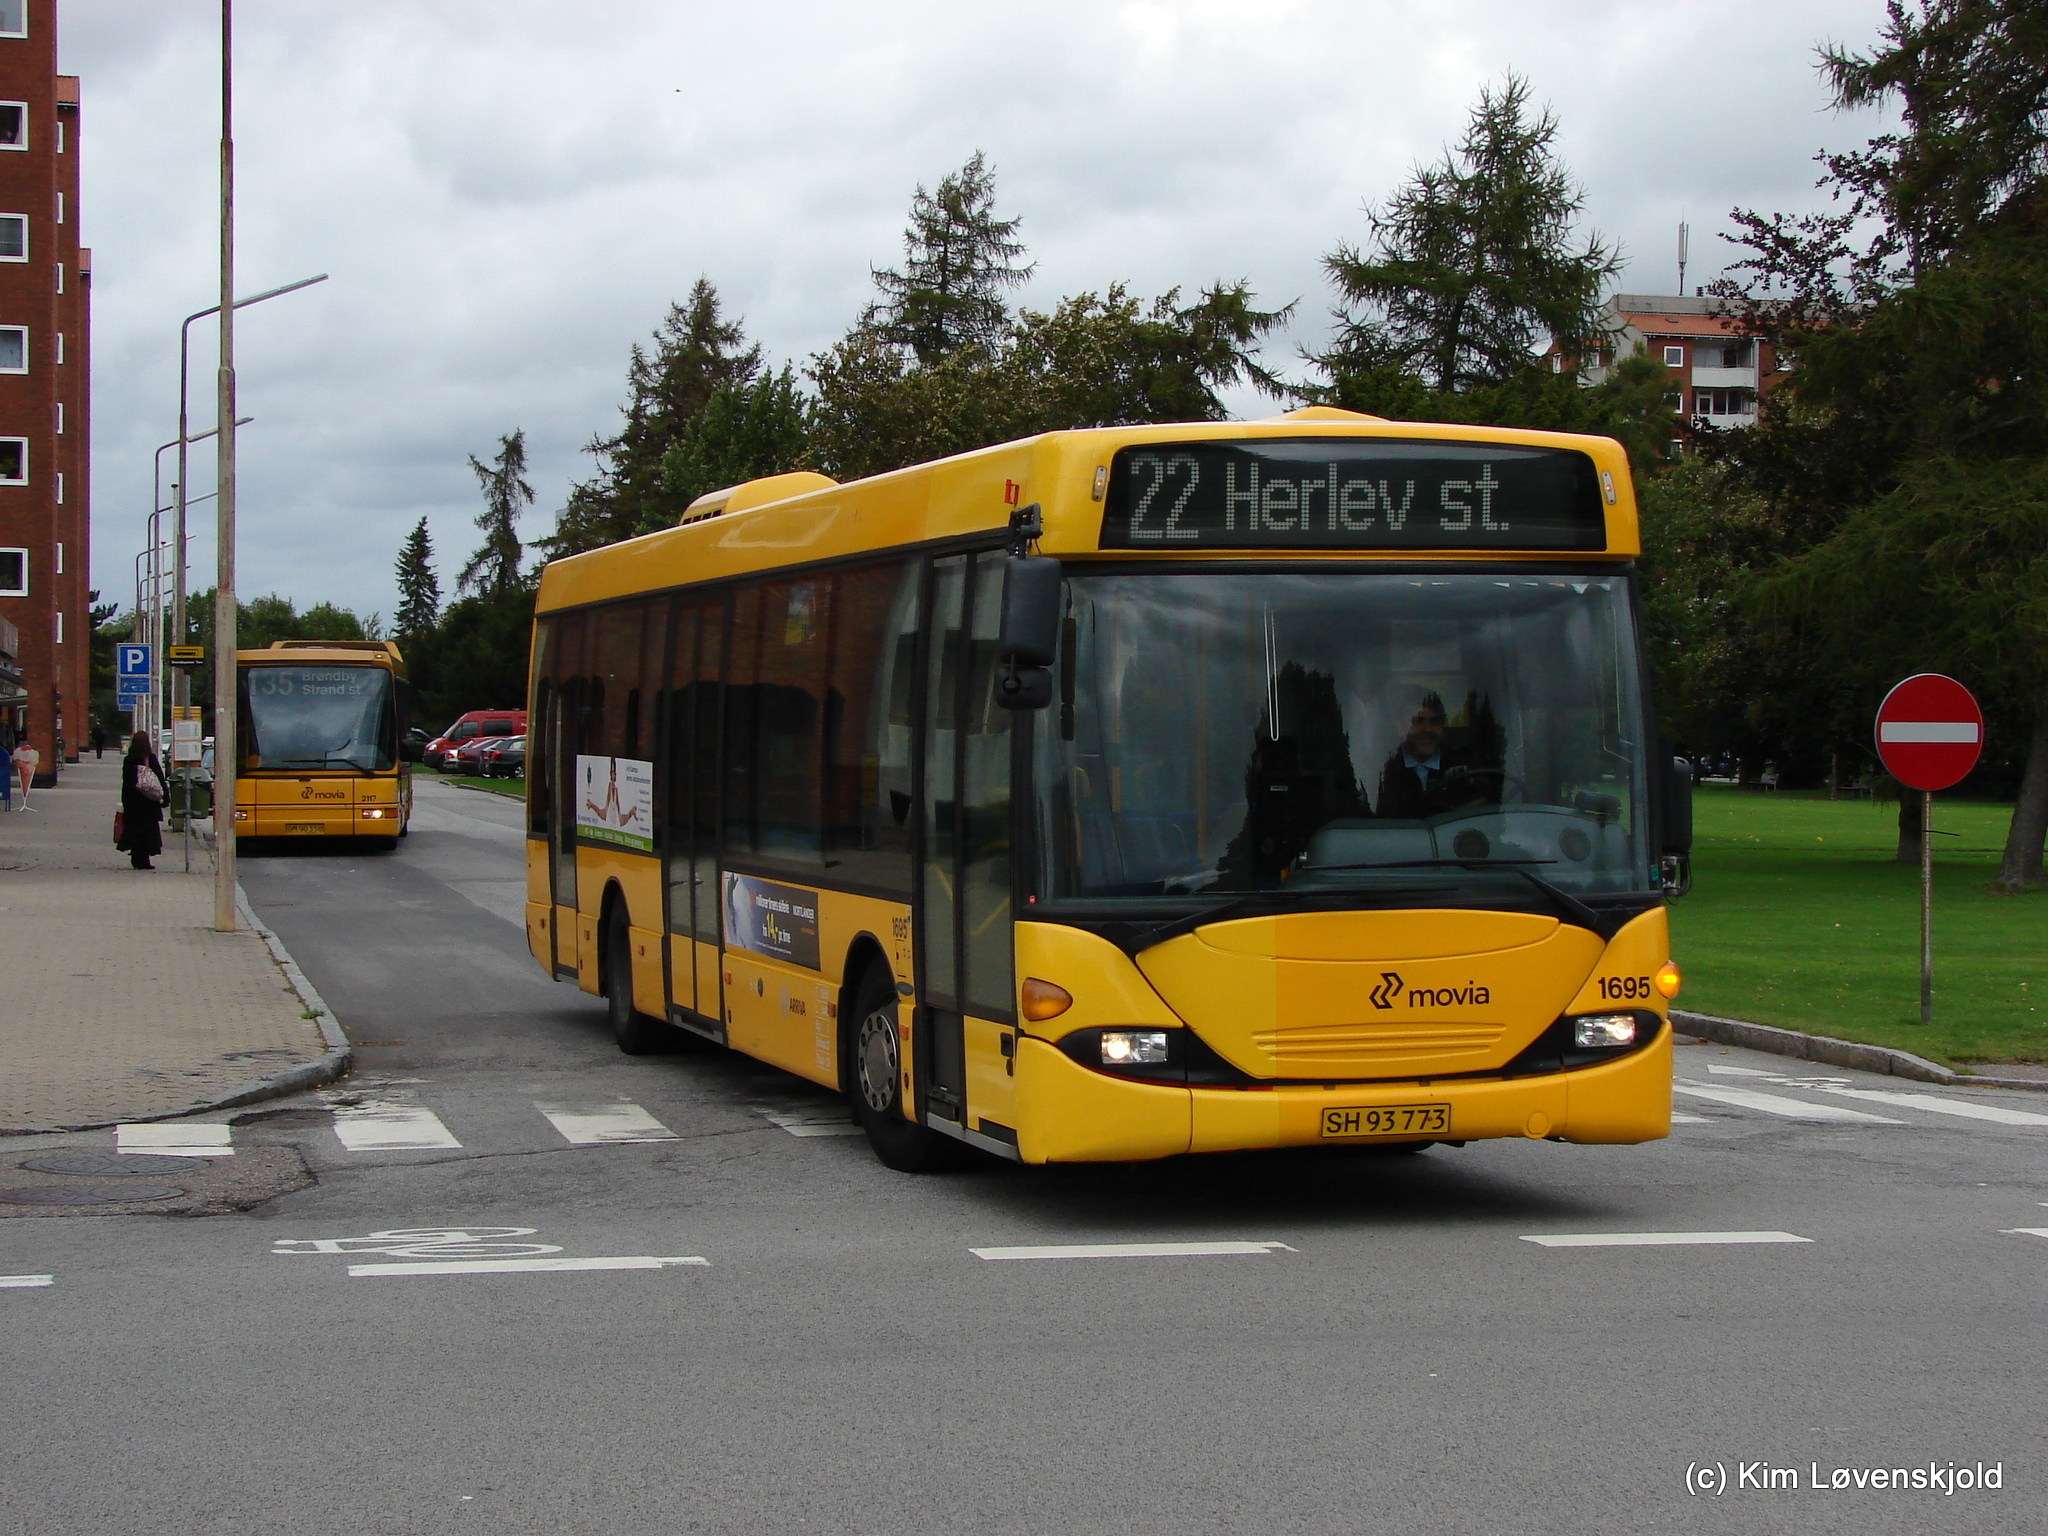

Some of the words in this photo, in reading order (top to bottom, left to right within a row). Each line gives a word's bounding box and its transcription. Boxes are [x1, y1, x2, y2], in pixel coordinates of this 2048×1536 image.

[1129, 453, 1200, 540] 22
[1225, 461, 1415, 531] Herlev
[1439, 463, 1510, 531] st.
[127, 648, 144, 673] P
[302, 671, 358, 683] Brøndby
[302, 684, 345, 695] Strand
[315, 789, 345, 799] movia
[892, 917, 908, 939] 1695
[1408, 980, 1490, 1007] movia
[1597, 976, 1650, 999] 1695
[1326, 1111, 1360, 1133] SH
[1368, 1110, 1395, 1132] 93
[1402, 1108, 1446, 1131] 773
